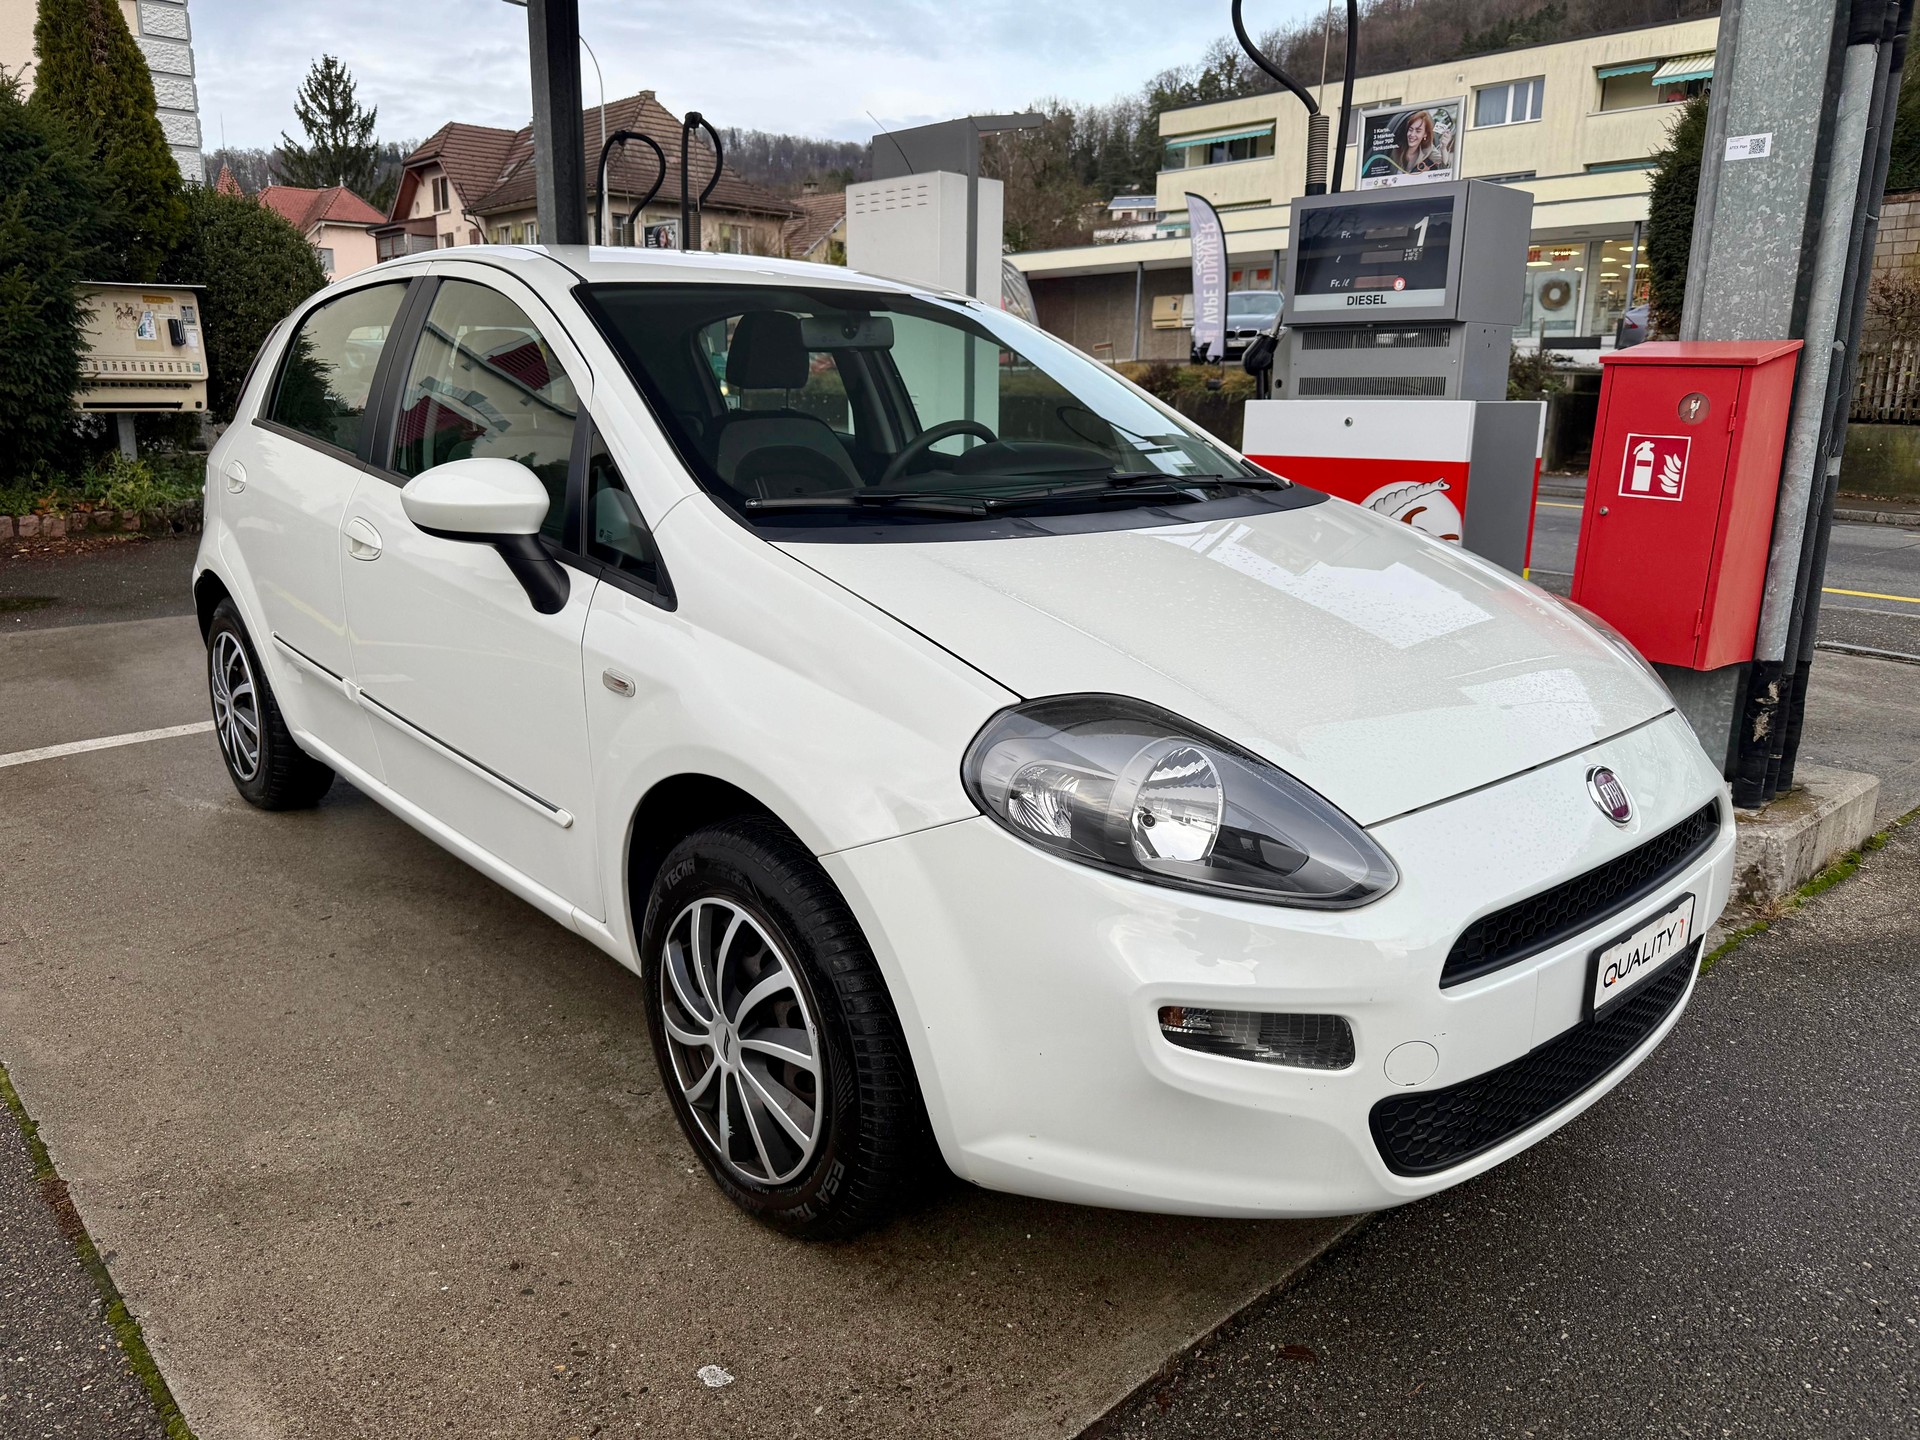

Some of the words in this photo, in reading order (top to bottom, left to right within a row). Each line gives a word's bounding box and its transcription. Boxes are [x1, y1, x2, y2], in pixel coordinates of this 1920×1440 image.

[1341, 230, 1351, 239] Fr.
[1414, 216, 1429, 246] 1
[1347, 294, 1387, 306] DIESEL
